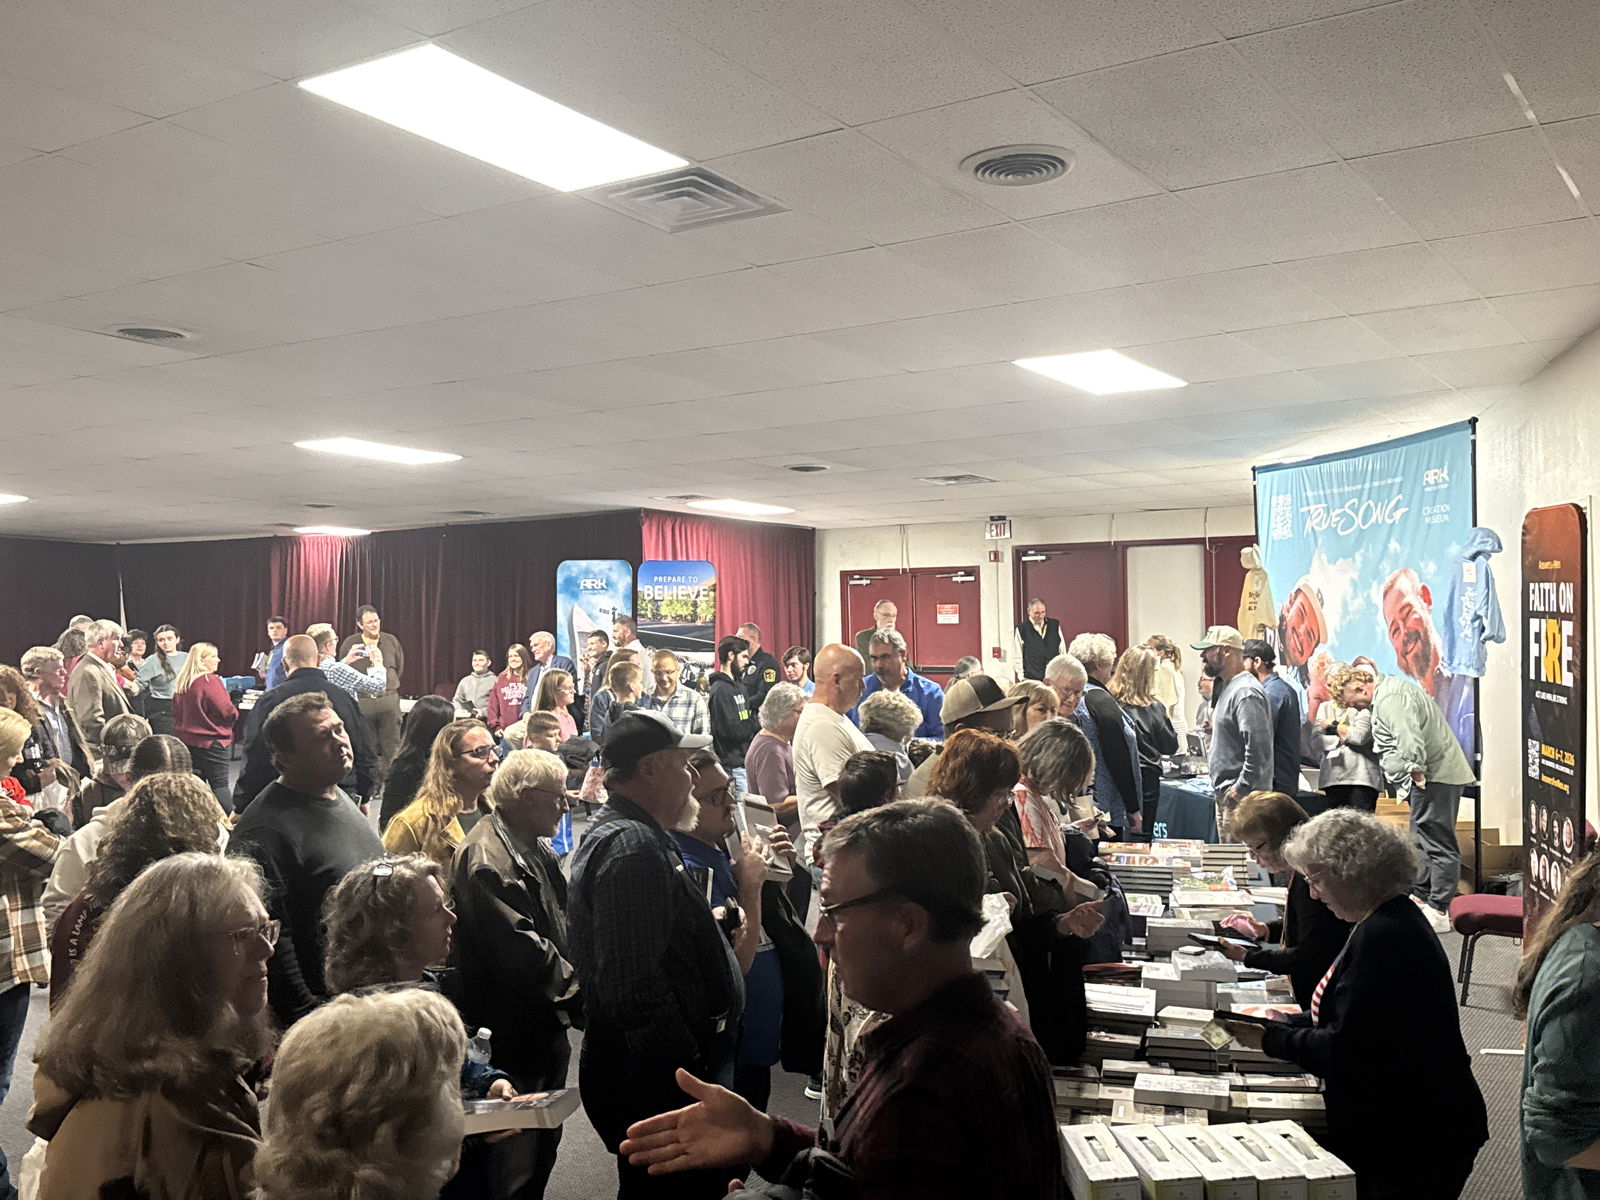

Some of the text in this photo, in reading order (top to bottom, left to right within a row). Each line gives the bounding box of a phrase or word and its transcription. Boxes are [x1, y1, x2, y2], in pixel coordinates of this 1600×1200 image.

[1423, 464, 1450, 484] ARK
[990, 522, 1006, 537] EXIT
[579, 577, 608, 590] ARK
[653, 575, 686, 583] PREPARE
[643, 585, 710, 600] BELIEVE
[1529, 581, 1574, 614] FAITH ON
[1529, 616, 1574, 688] FIRE
[69, 938, 78, 946] A
[68, 948, 77, 956] IS
